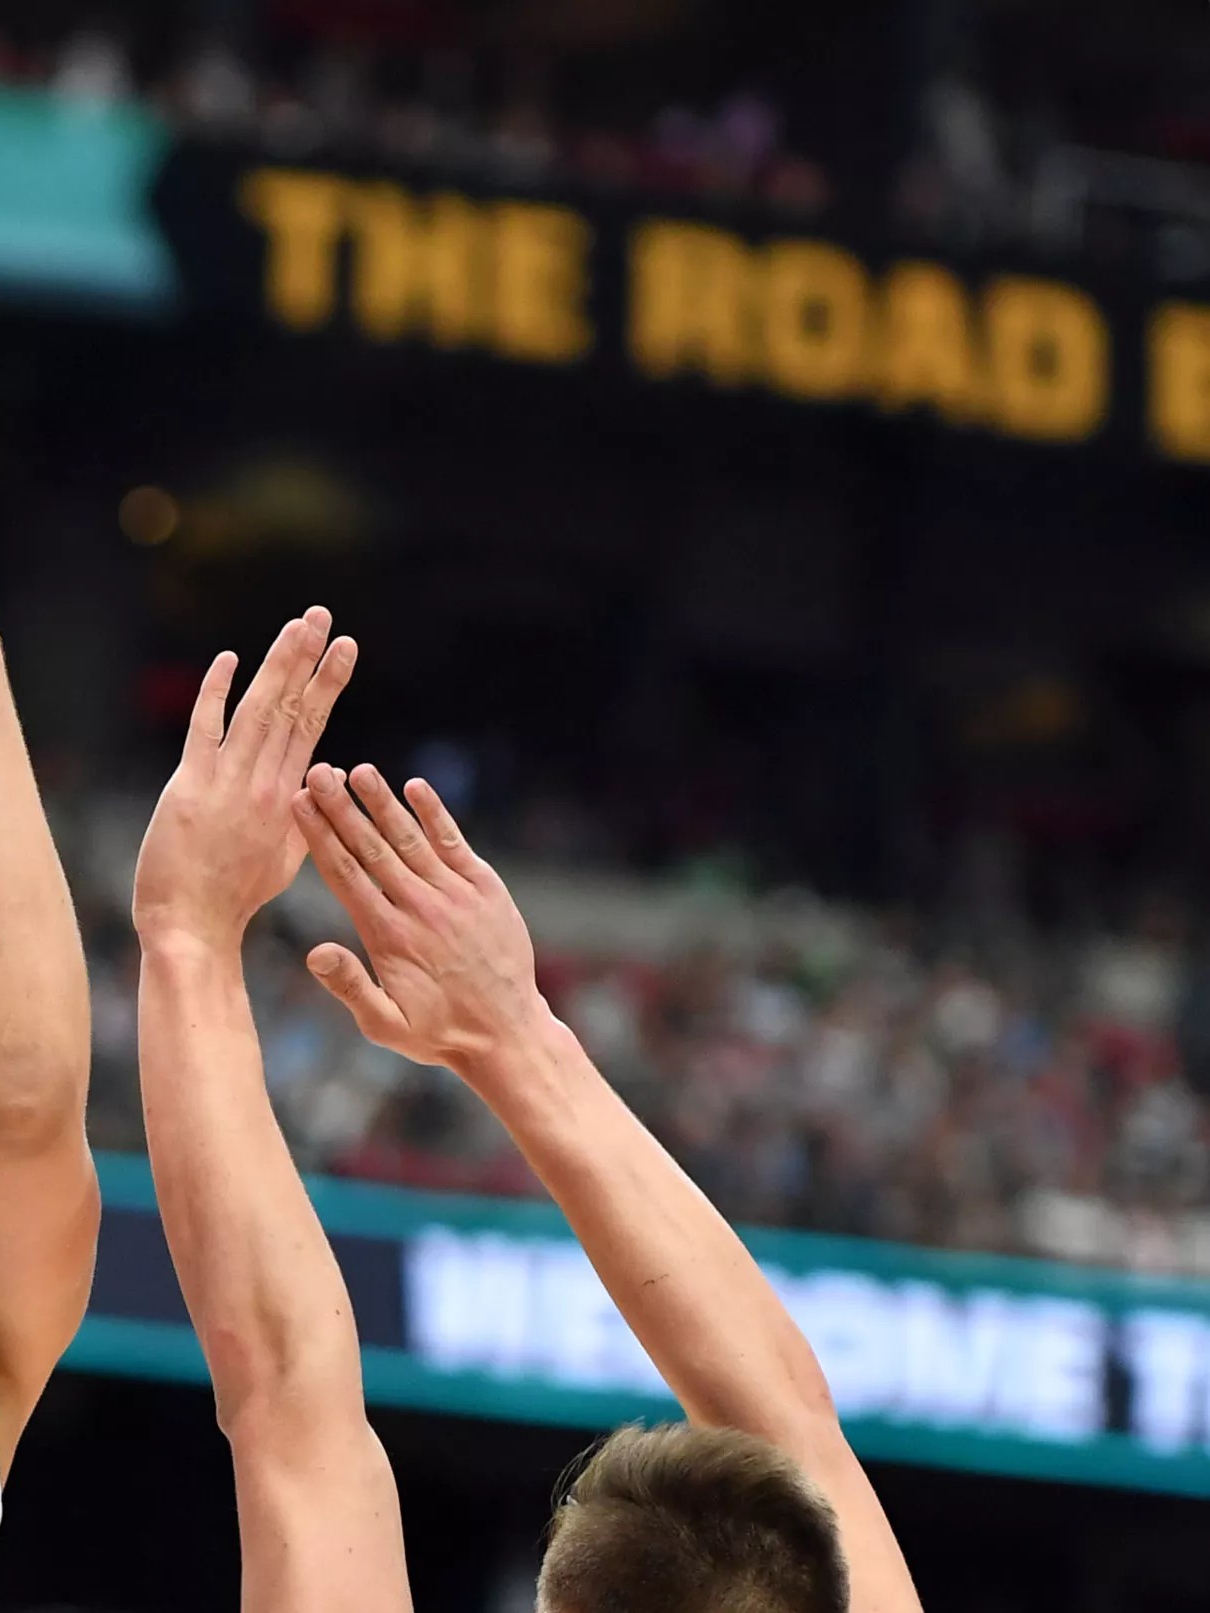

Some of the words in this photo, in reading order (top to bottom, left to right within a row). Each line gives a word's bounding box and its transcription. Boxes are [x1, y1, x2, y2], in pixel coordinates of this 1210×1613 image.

[242, 169, 592, 361] THE
[628, 220, 1110, 440] ROAD
[404, 1224, 1106, 1442] WEOME
